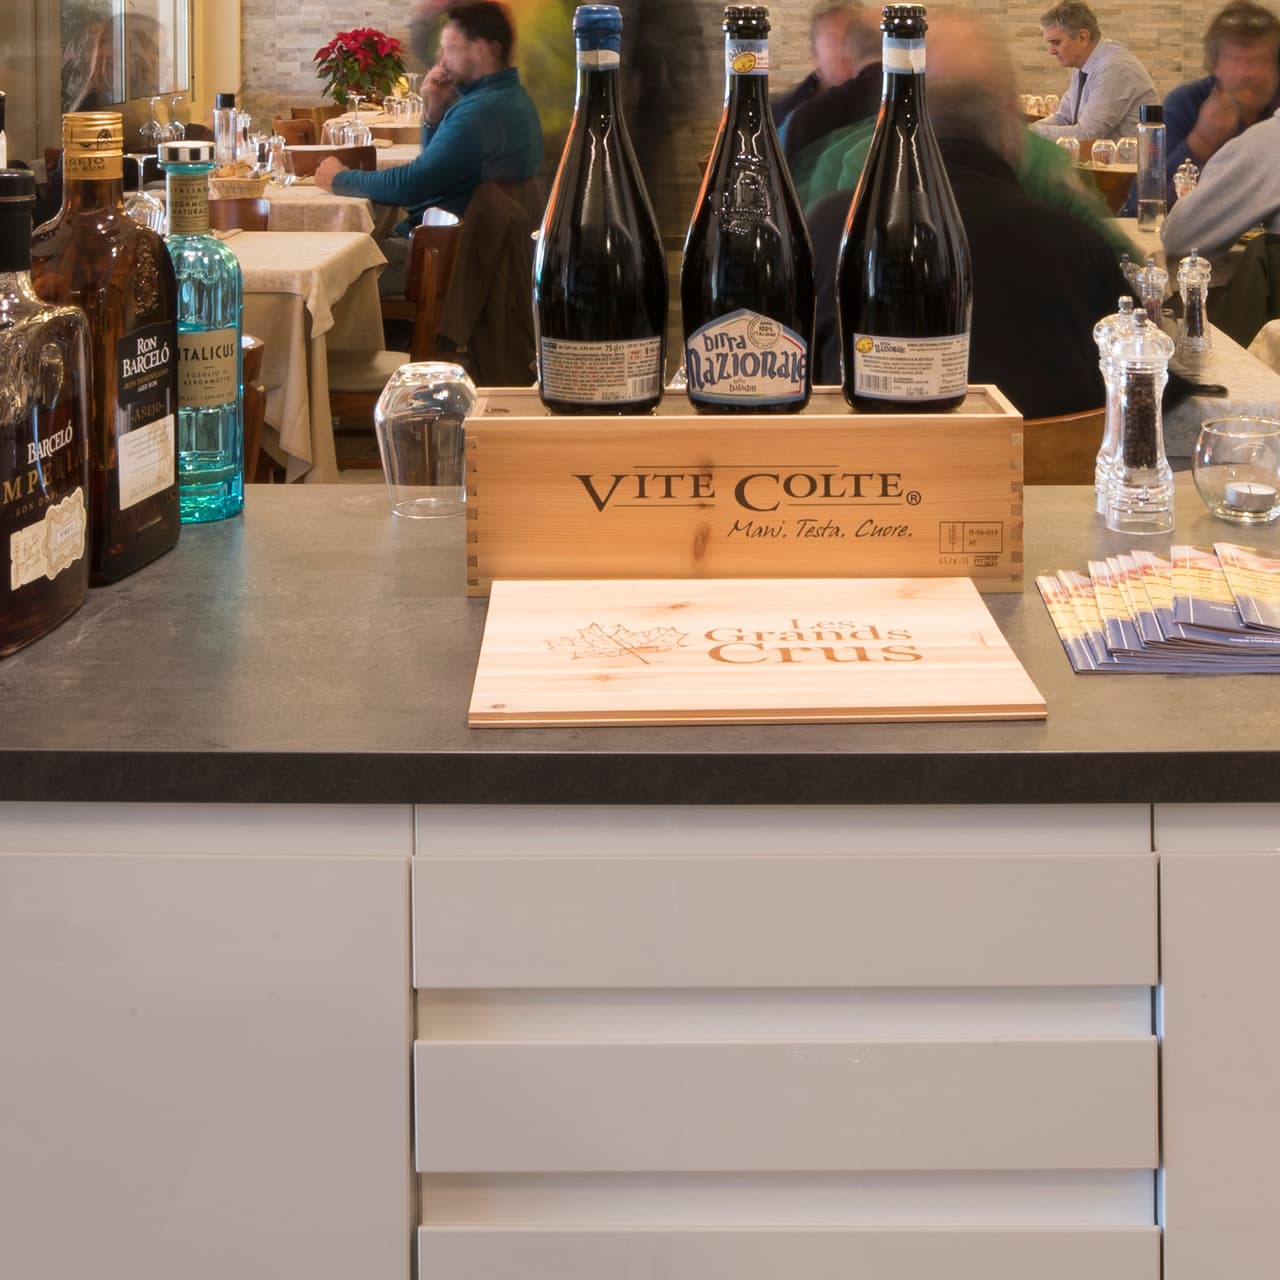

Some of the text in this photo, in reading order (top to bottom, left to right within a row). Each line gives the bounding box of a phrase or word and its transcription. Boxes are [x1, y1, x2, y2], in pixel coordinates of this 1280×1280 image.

[27, 419, 74, 465] BARCELÓ
[575, 472, 904, 513] VITE COLTE
[795, 519, 845, 539] Testa.
[854, 519, 913, 539] Cuore.
[704, 625, 913, 643] Grands
[789, 618, 855, 630] Les
[708, 642, 923, 665] Crus
